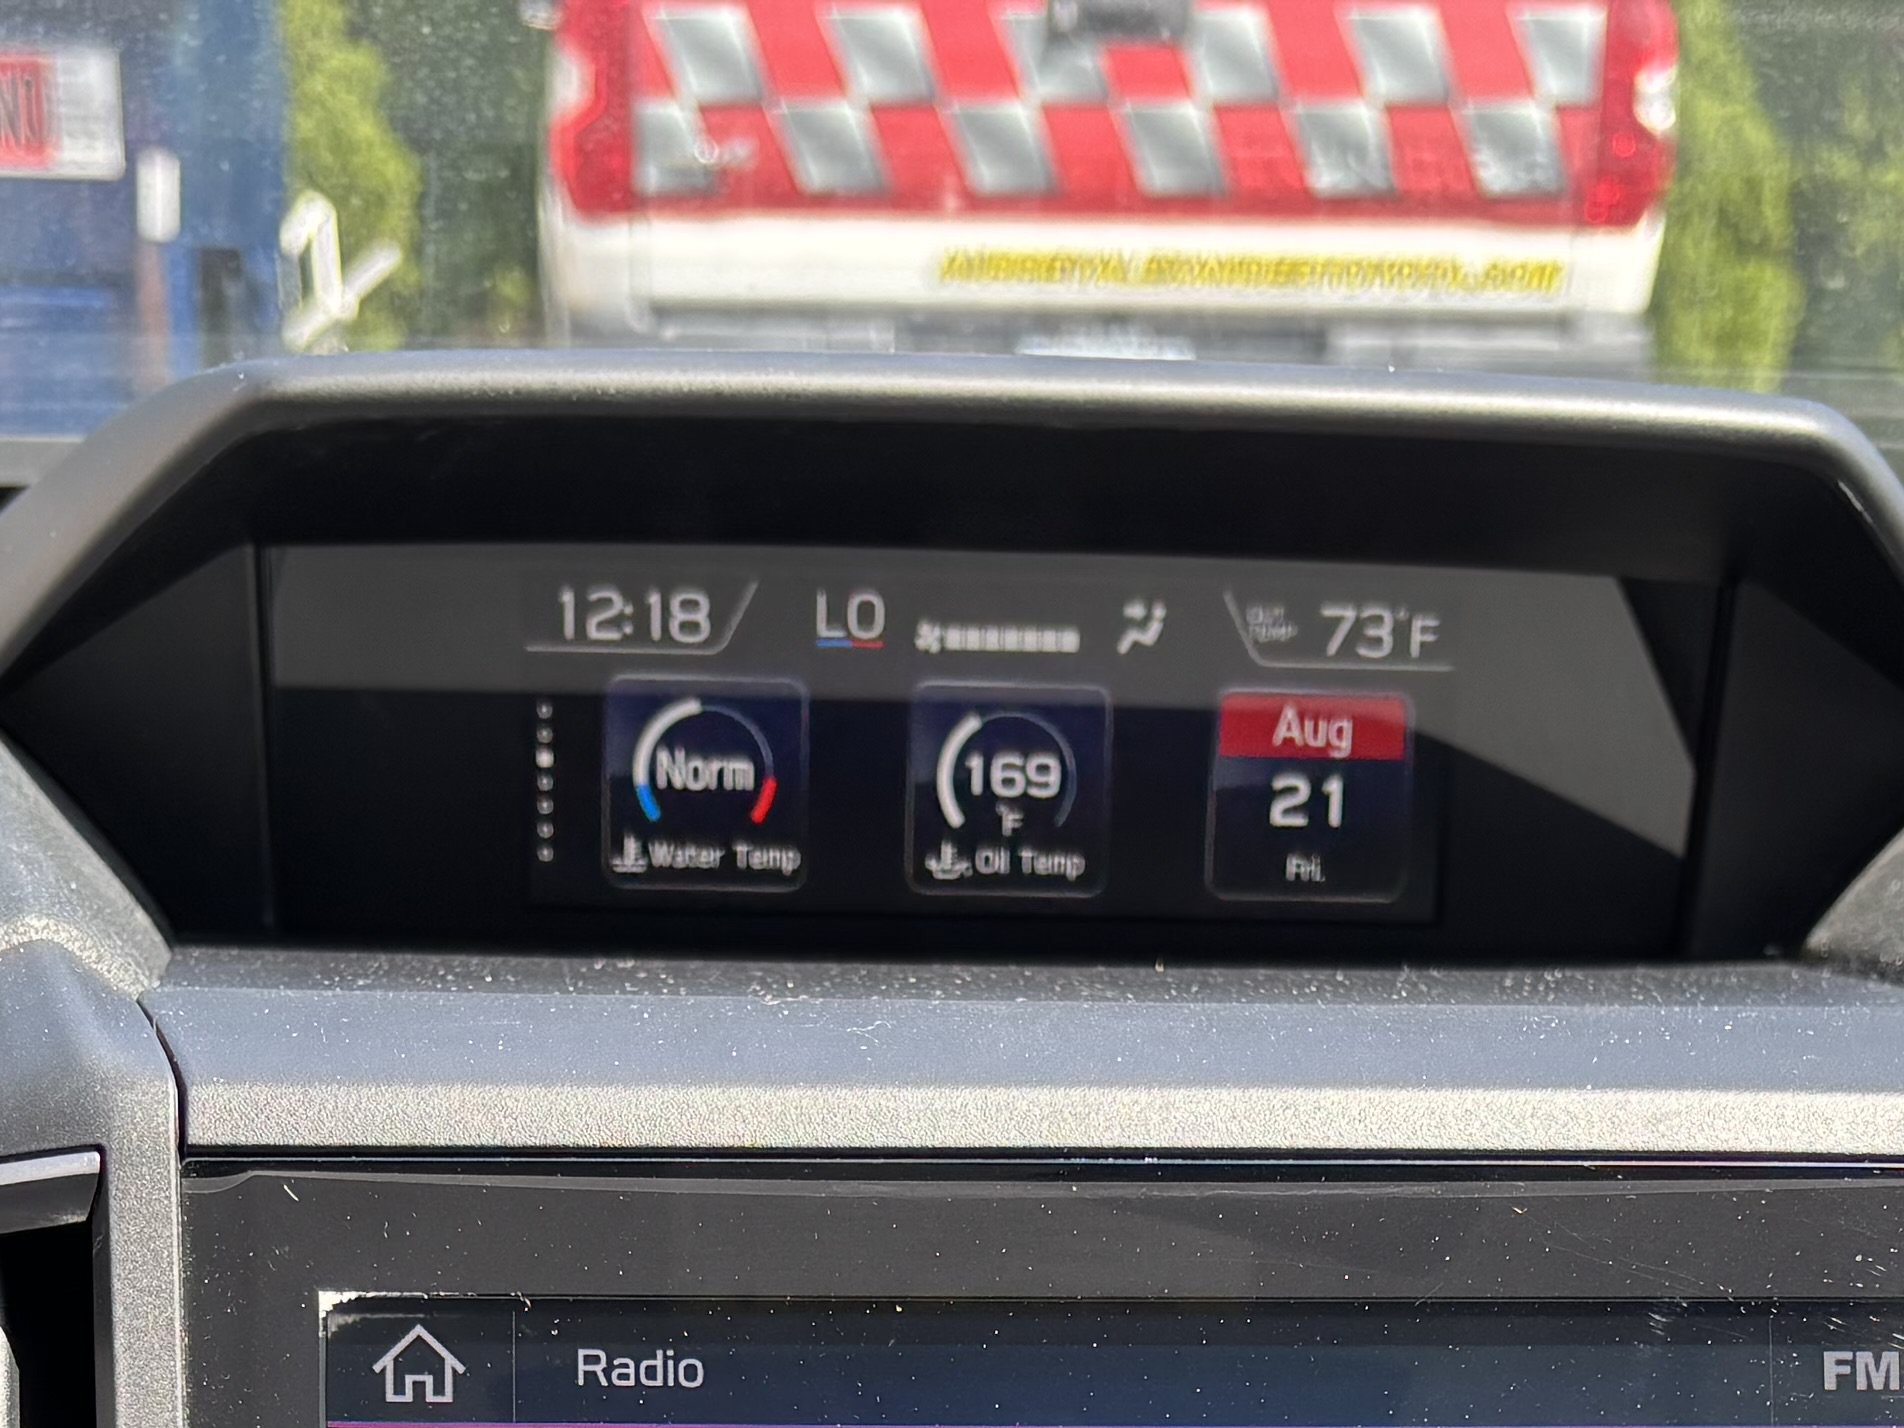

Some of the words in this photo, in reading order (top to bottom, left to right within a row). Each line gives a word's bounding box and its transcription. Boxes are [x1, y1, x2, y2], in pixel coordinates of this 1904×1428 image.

[561, 588, 710, 643] 12:18
[816, 588, 885, 641] LO
[1272, 704, 1356, 757] Aug
[656, 747, 754, 790] Norm
[966, 753, 1061, 798] 169
[1270, 773, 1343, 827] 21
[644, 841, 725, 870] Water
[733, 841, 801, 875] Temp
[1018, 847, 1085, 880] Temp
[578, 1349, 704, 1387] Radio
[1824, 1351, 1899, 1390] FM
